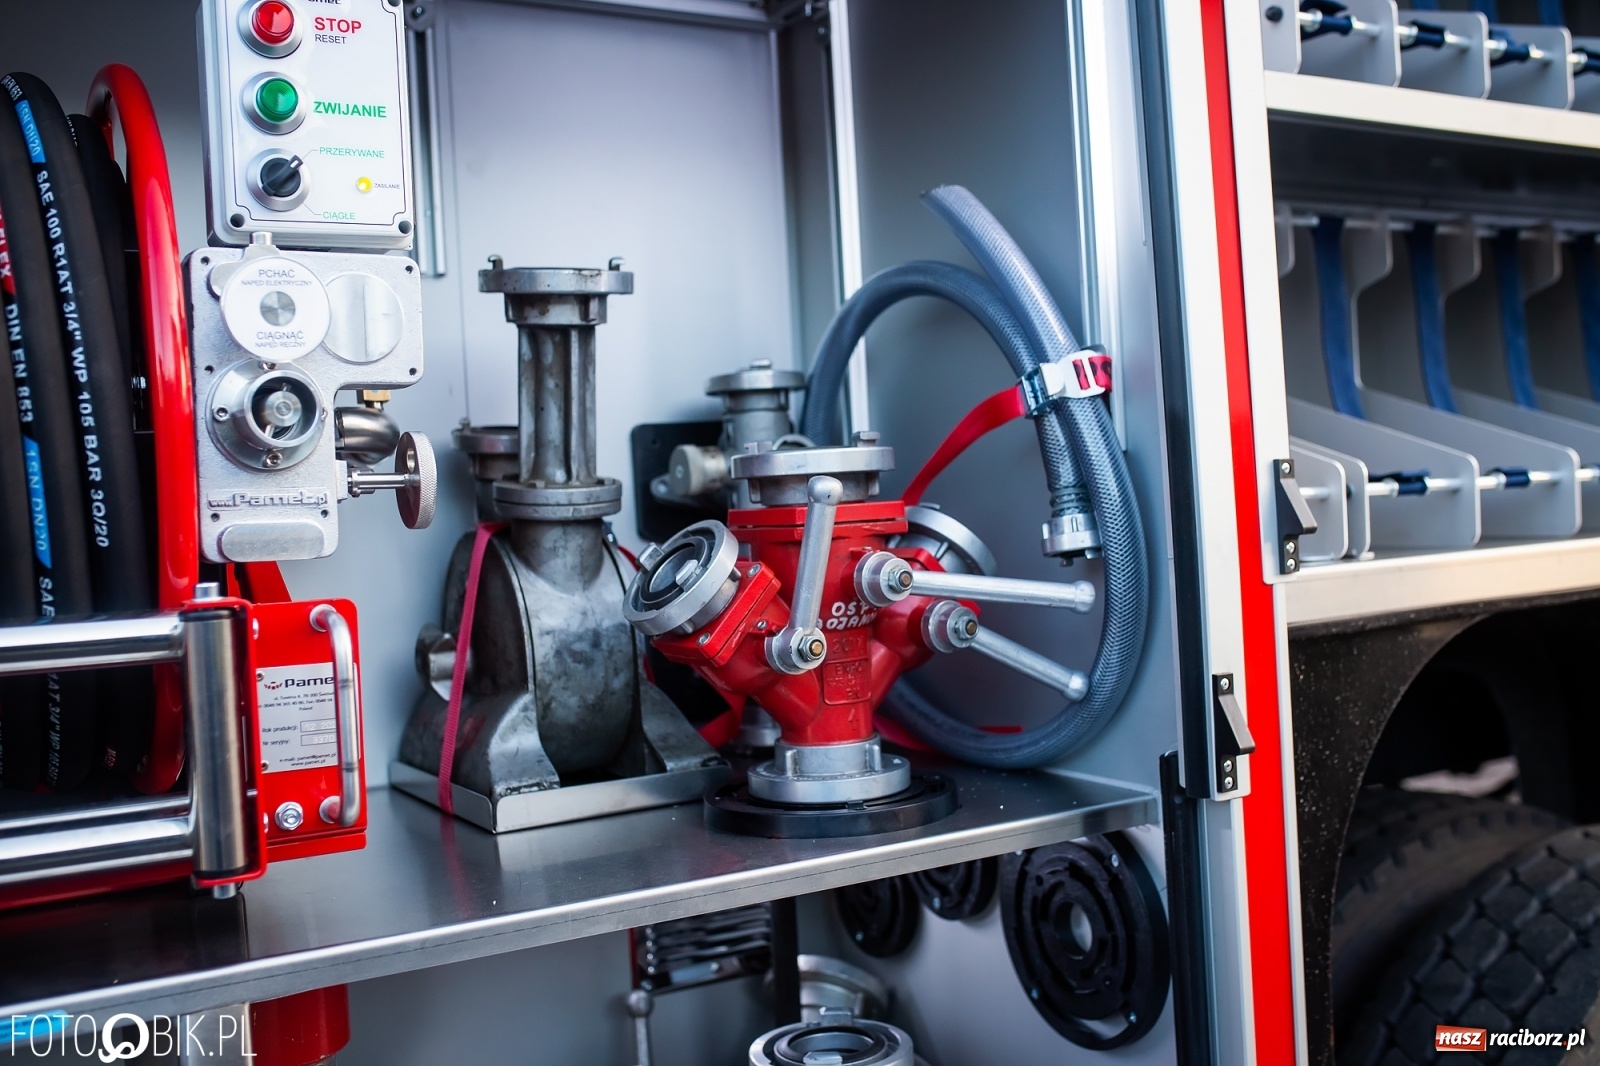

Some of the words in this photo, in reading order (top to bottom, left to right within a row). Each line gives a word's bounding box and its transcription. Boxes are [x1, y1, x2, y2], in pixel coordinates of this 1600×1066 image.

[314, 16, 362, 34] STOP
[314, 34, 347, 44] RESET
[313, 101, 387, 119] ZWIJANIE
[319, 146, 385, 159] PRZERYWANE
[36, 170, 55, 206] SAE
[45, 208, 62, 239] 100
[322, 211, 355, 220] CIĄGŁE
[52, 245, 73, 295] R1AT
[258, 269, 295, 278] PCHAĆ
[4, 304, 23, 342] DIN
[63, 302, 83, 341] 3/4"
[256, 330, 304, 341] CIĄGNĄĆ
[11, 348, 28, 378] EN
[71, 346, 88, 383] WP
[16, 386, 34, 423] 853
[77, 391, 96, 428] 105
[26, 449, 40, 489] 1SN
[83, 434, 103, 482] BAR
[31, 496, 47, 551] DN20
[90, 488, 110, 548] 3Q/20
[38, 575, 56, 619] SAE
[285, 676, 334, 688] Pame
[320, 721, 336, 729] 202
